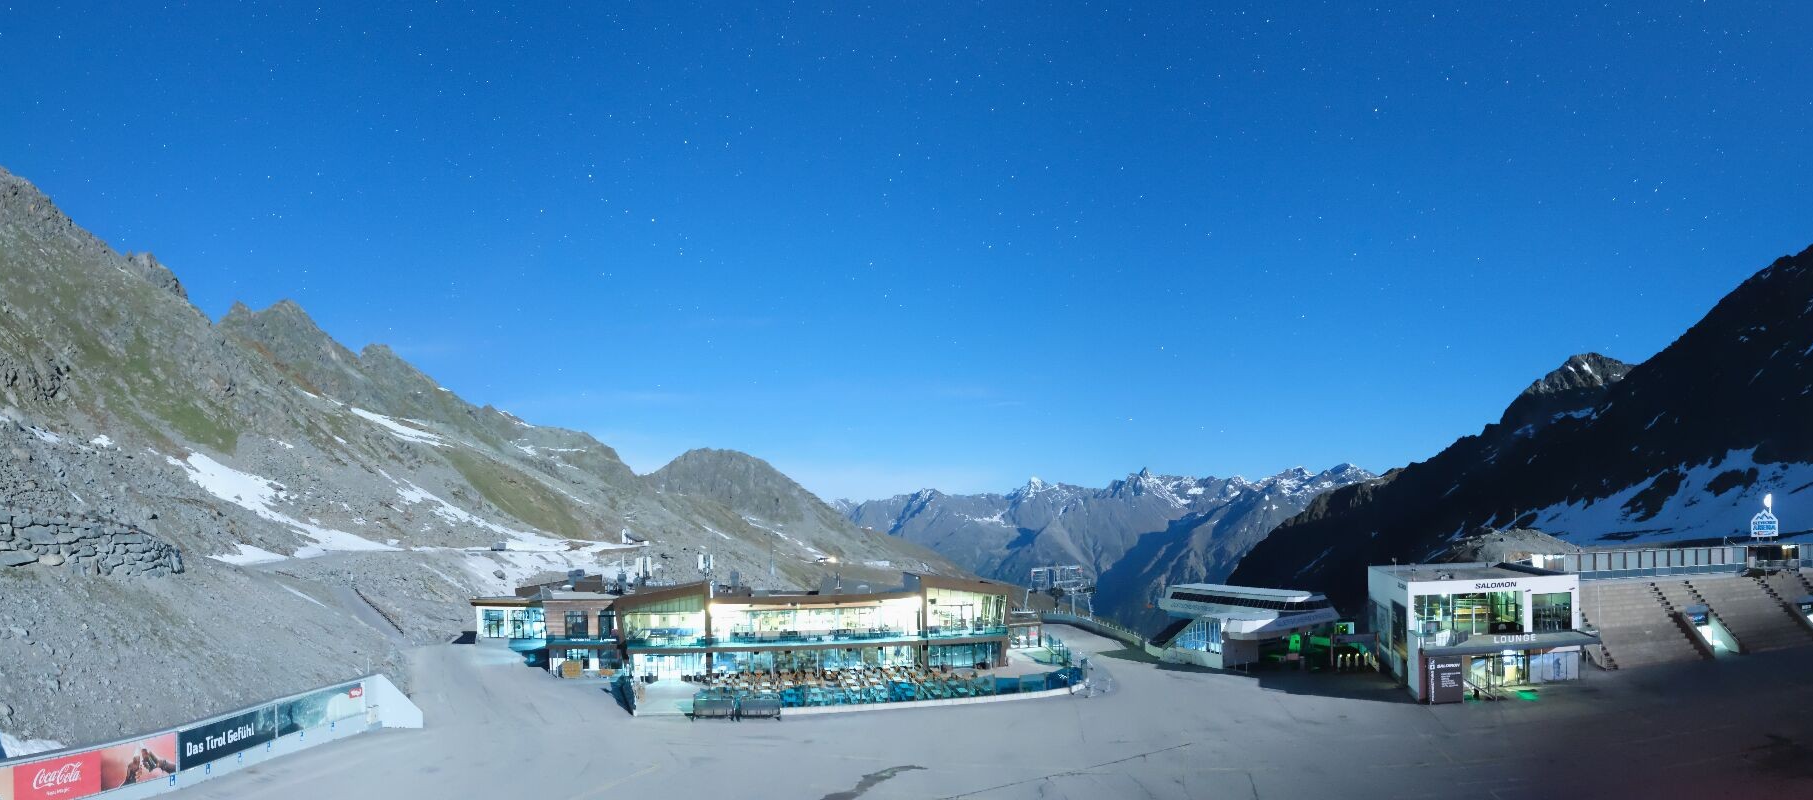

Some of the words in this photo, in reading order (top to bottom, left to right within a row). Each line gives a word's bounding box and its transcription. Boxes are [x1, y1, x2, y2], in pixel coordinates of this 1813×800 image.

[1475, 581, 1517, 589] SALOMON
[1493, 633, 1537, 644] LOUNGE
[186, 741, 204, 758] Das
[205, 730, 226, 751] Tirol
[227, 722, 255, 744] Gefühl
